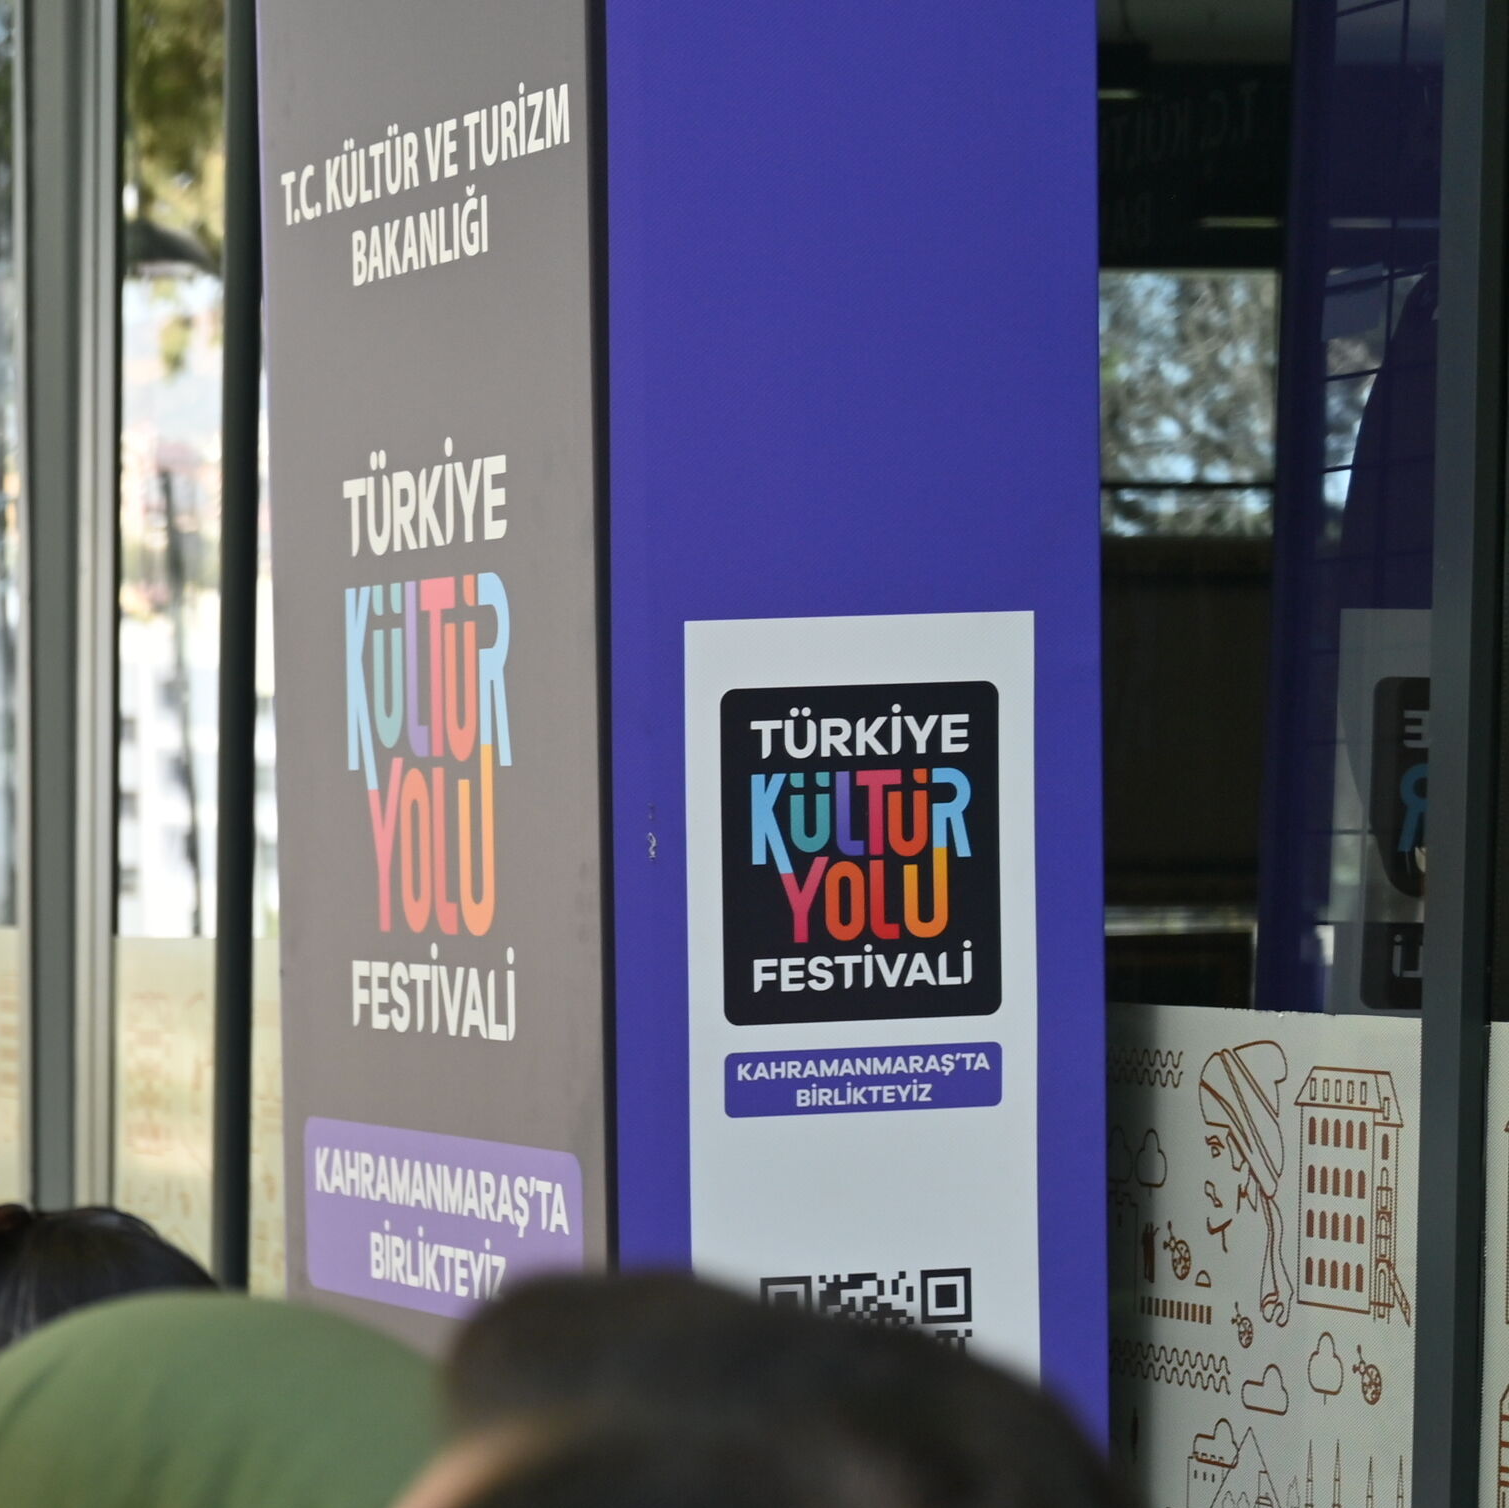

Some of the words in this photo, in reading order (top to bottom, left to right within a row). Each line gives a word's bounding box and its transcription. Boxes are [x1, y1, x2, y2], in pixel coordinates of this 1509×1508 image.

[281, 164, 322, 226] T.C.
[325, 123, 419, 213] KÜLTÜR
[424, 118, 459, 182] VE
[463, 82, 570, 171] TURİZM
[352, 184, 488, 286] BAKANLIĞI
[343, 437, 507, 557] TÜRKİYE
[345, 572, 512, 785] KÜLTÜR
[750, 703, 970, 759] TÜRKİYE
[367, 747, 497, 936] YOLU
[751, 767, 972, 872] KÜLTÜR
[780, 848, 949, 943] YOLU
[352, 942, 516, 1042] FESTİVALİ
[752, 940, 972, 993] FESTİVALİ
[737, 1052, 990, 1082] KAHRAMANMARAŞ'TA
[796, 1079, 932, 1108] BİRLİKTEYİZ
[315, 1146, 571, 1238] KAHRAMANMARAŞ'TA
[370, 1220, 506, 1301] BİRLİKTEYİZ
